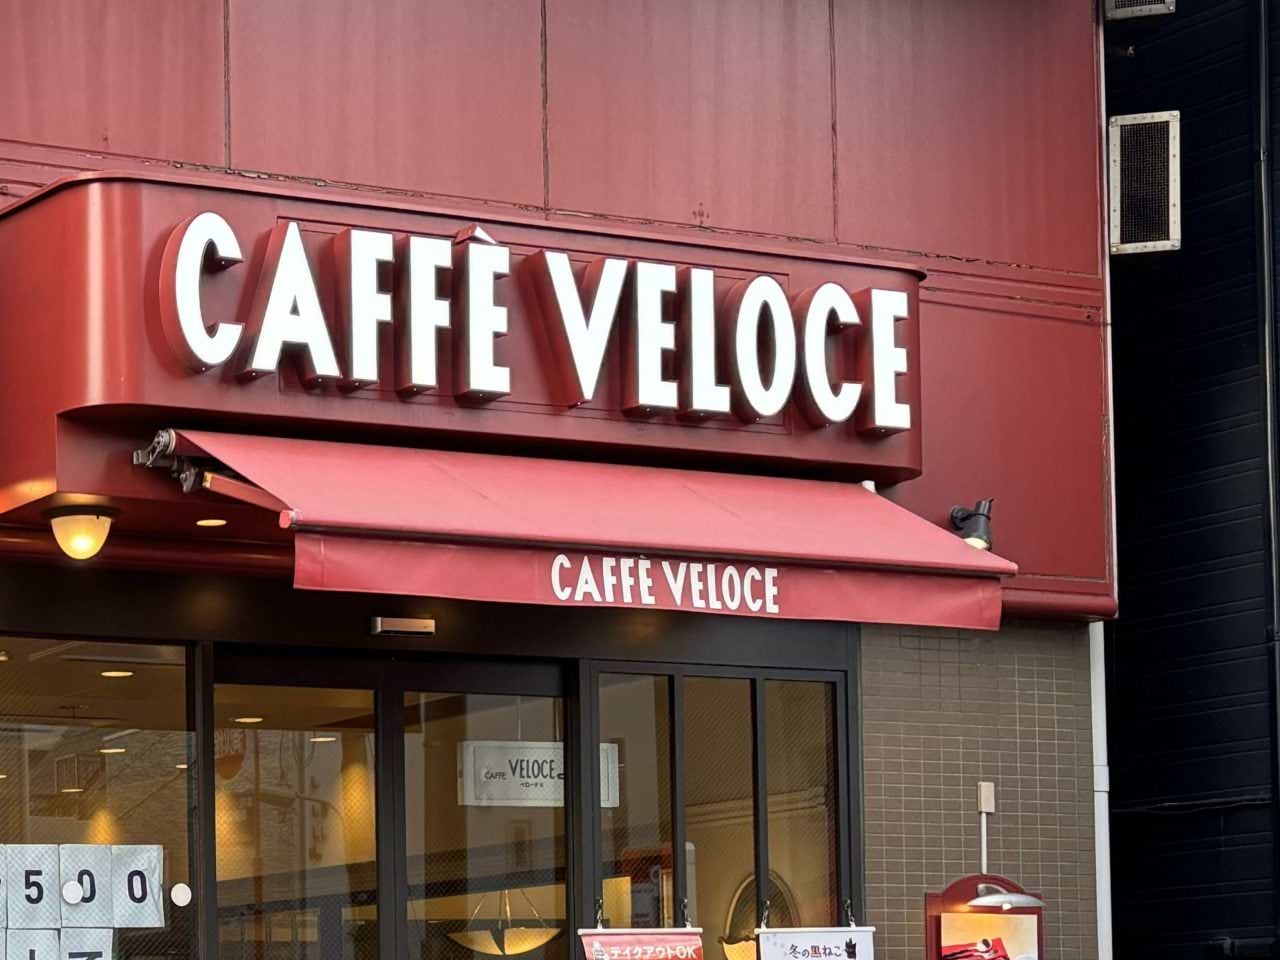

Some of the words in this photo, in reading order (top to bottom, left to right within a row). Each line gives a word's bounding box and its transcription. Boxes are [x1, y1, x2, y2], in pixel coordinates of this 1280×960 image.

[543, 250, 912, 429] VELOCE
[661, 560, 780, 614] VELOCE
[508, 759, 556, 780] VELOCE
[609, 946, 697, 960] テイクアウトOK
[789, 944, 843, 959] 冬の黒ねこ
